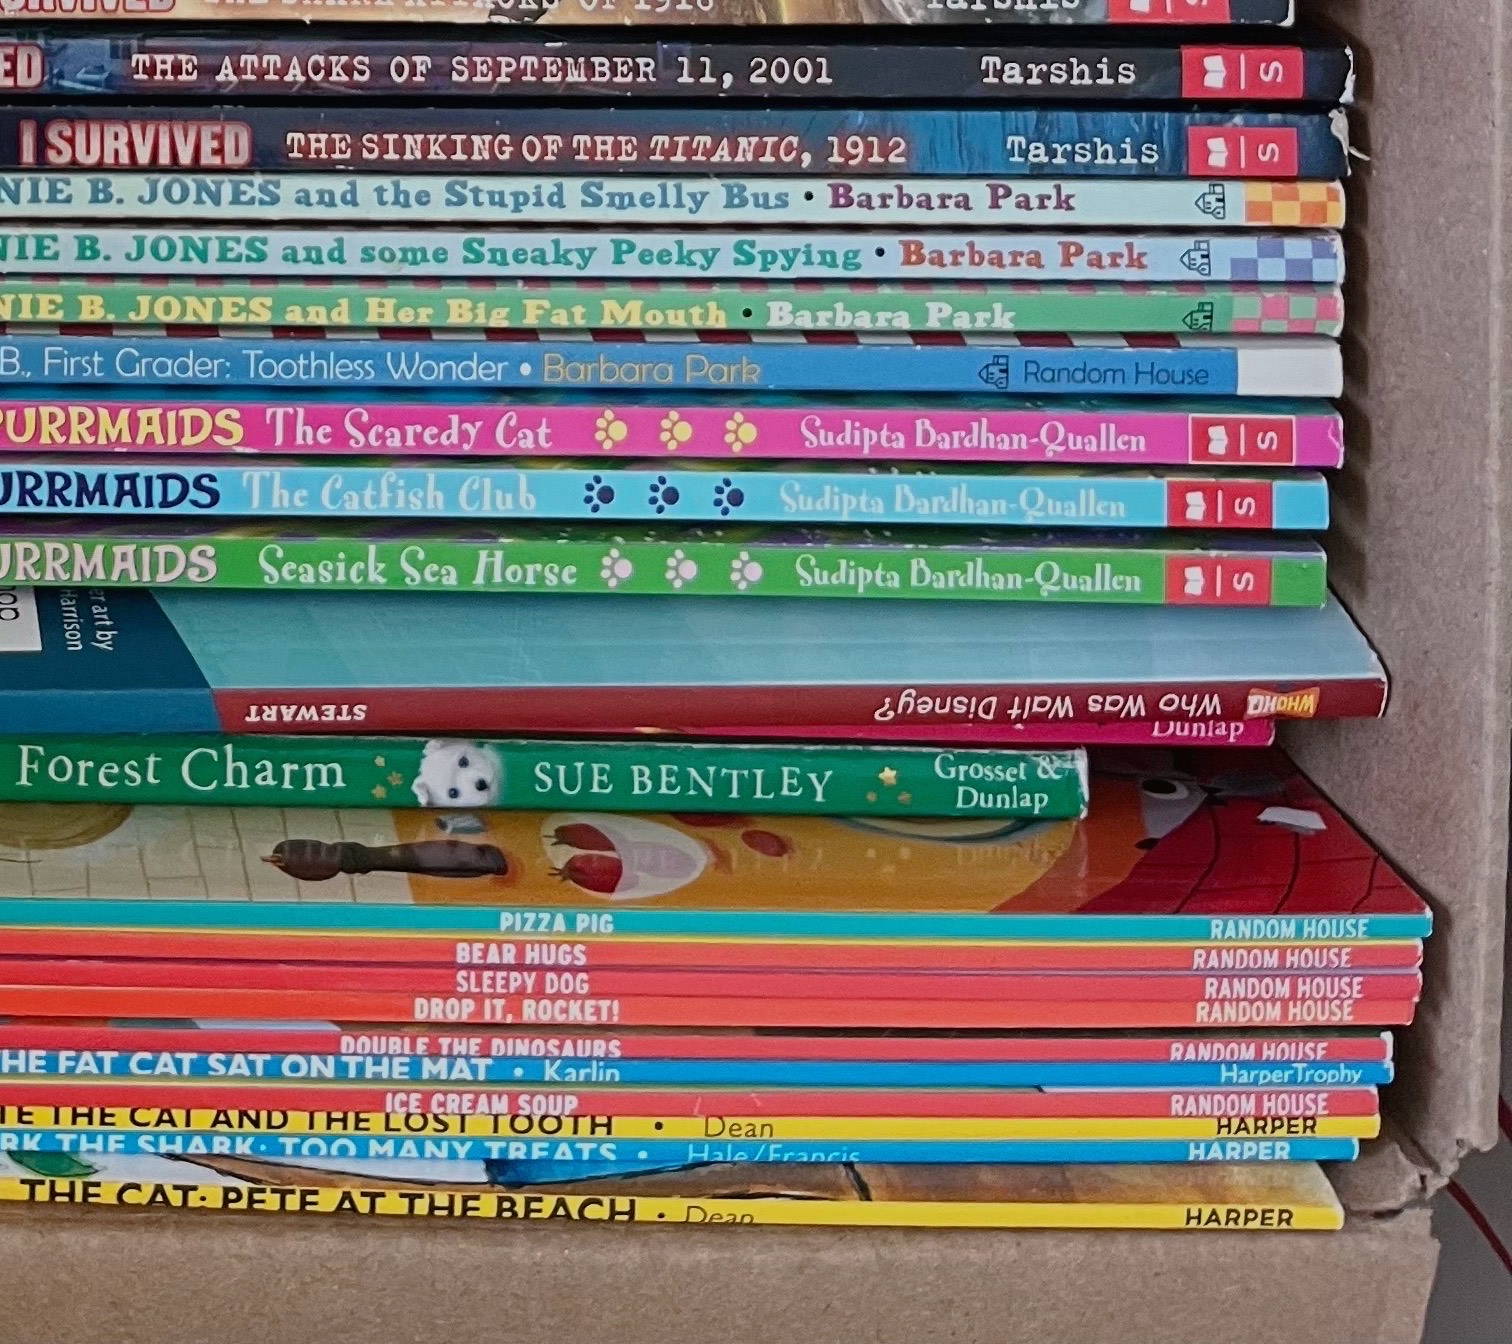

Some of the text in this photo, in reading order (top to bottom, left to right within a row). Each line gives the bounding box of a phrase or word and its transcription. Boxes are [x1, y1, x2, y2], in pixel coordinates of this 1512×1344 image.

[131, 54, 197, 81] THE
[216, 54, 370, 82] ATTACKS
[390, 55, 431, 82] OF
[452, 56, 657, 83] SEPTEMBER
[749, 57, 833, 85] 2001
[981, 55, 1136, 85] Tarshis
[74, 235, 112, 263] B.
[131, 236, 268, 265] JONES
[282, 239, 345, 265] and
[360, 244, 449, 266] some
[463, 240, 596, 269] Sneaky
[610, 241, 720, 273] Peeky
[733, 241, 862, 273] Spying
[898, 242, 1148, 270] Barbara Park
[348, 412, 483, 451] Scaredy
[495, 414, 551, 447] Cat
[800, 414, 1146, 454] Sudipta Bardhan-Quallen
[245, 700, 366, 721] STEWART
[874, 690, 1221, 720] Who Was Walt Disney?
[18, 747, 160, 788] Forest
[181, 749, 344, 790] Charm
[535, 761, 833, 803] SUE BENTLEY
[1036, 754, 1058, 781] &
[955, 783, 1049, 813] Dunlap
[500, 912, 614, 932] PIZZA PIG
[1210, 918, 1368, 939] RANDOM HOUSE
[456, 945, 587, 964] BEAR HUGS
[455, 973, 589, 995] SLEEPY DOG
[1185, 1207, 1294, 1229] HARPER
